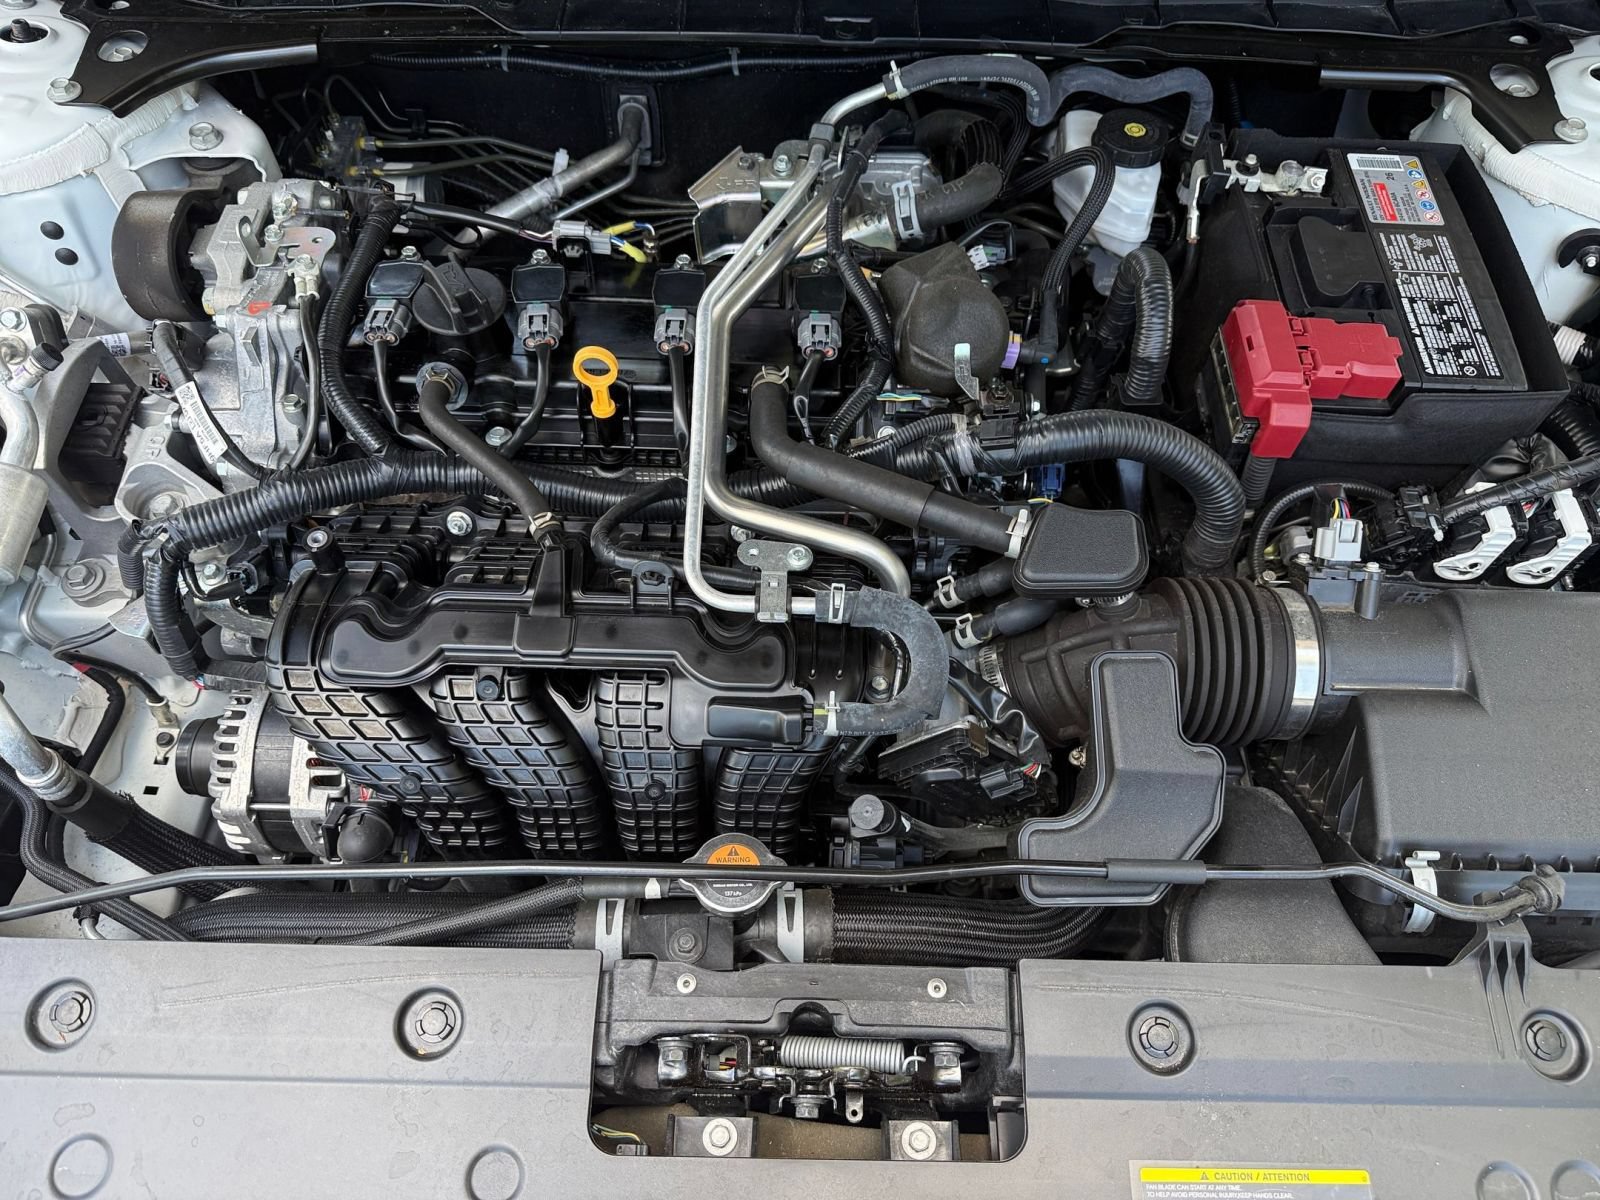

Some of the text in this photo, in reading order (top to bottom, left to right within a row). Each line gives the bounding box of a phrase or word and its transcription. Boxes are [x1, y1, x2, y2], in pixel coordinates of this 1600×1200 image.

[1384, 172, 1395, 181] 26
[1359, 178, 1371, 199] NISSAN
[1366, 199, 1379, 221] RENAULT
[1214, 1172, 1253, 1181] CAUTION
[1262, 1172, 1310, 1182] ATTENTION
[1188, 1191, 1218, 1199] PERSONAL
